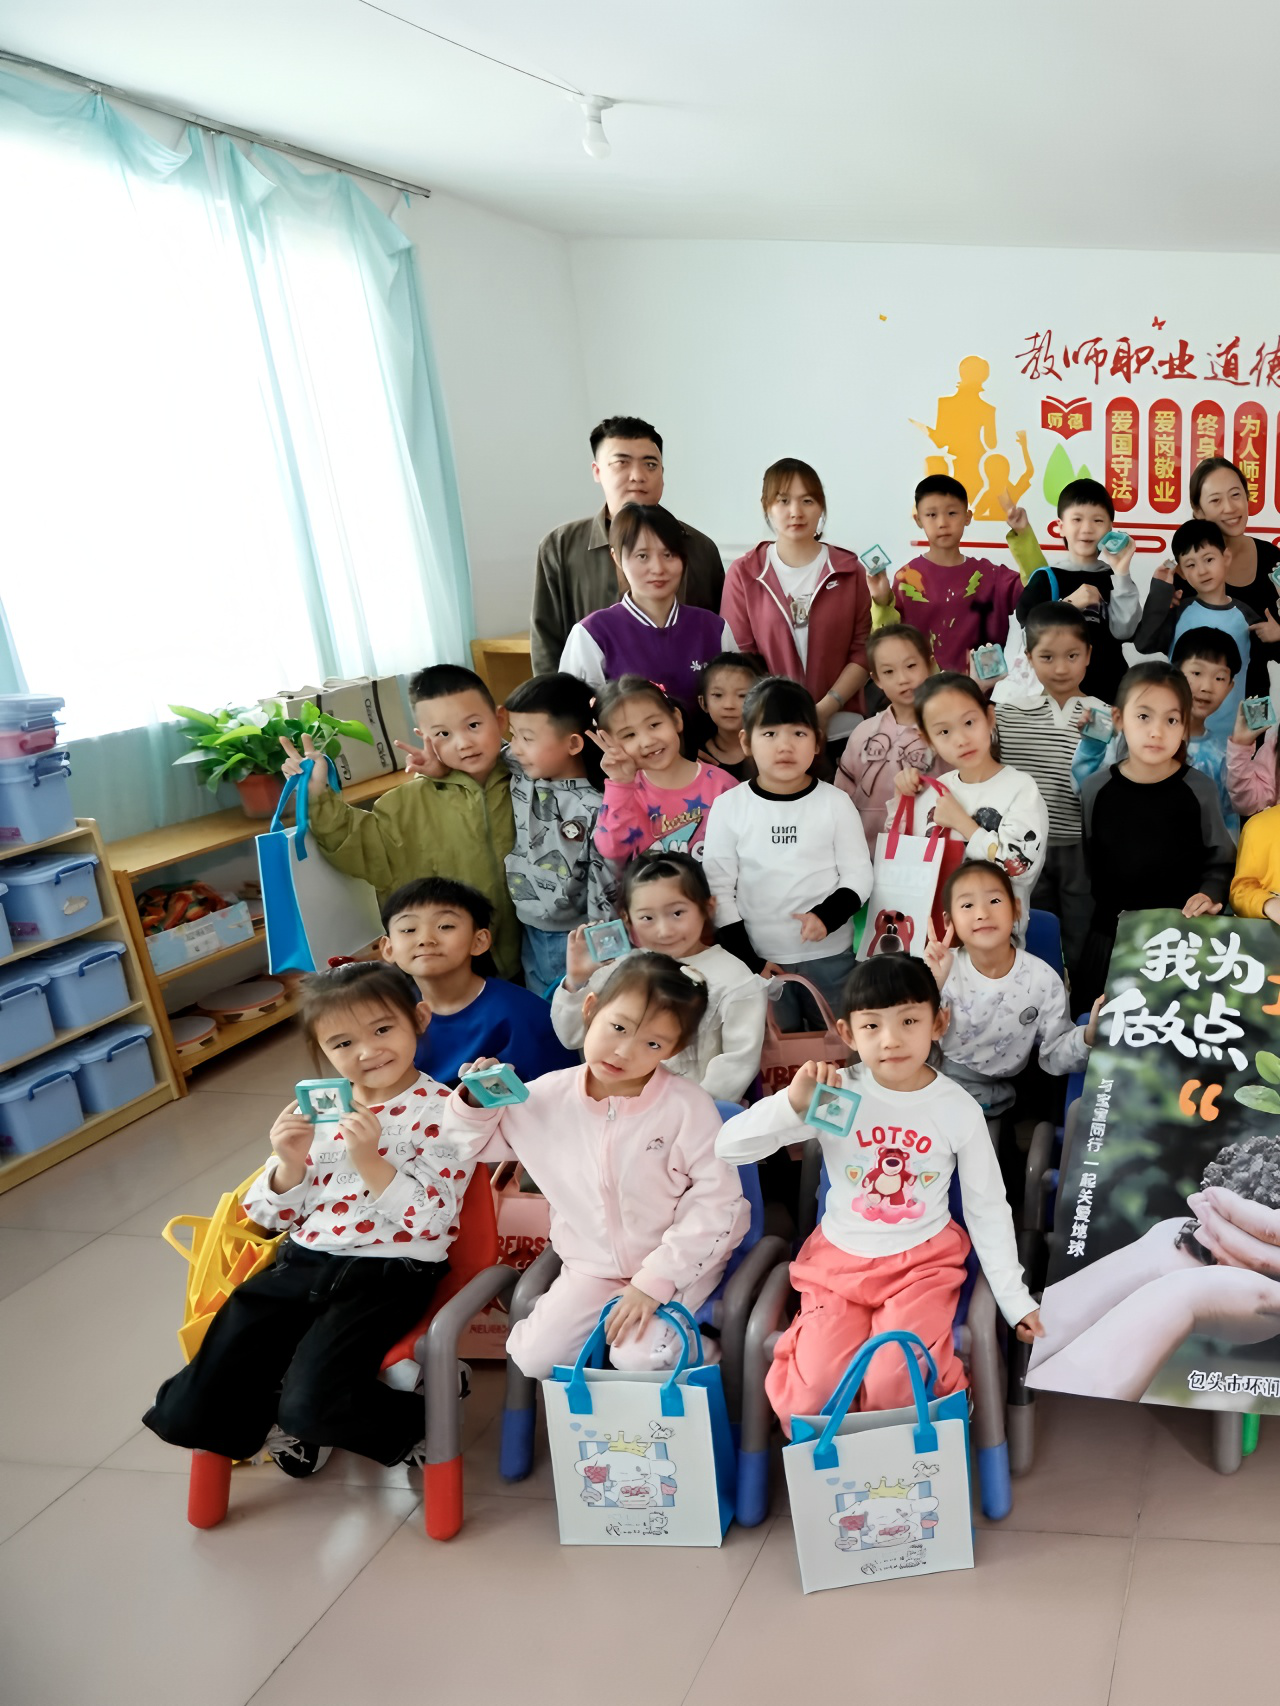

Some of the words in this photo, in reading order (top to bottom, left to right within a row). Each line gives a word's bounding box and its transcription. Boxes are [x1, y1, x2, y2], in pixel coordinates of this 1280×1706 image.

[1047, 412, 1084, 430] 师德
[1111, 410, 1133, 500] 爱国守法
[1195, 413, 1218, 467] 终身
[1154, 410, 1176, 503] 爱岗敬业
[1099, 988, 1249, 1071] 做点
[856, 1126, 932, 1154] LOTSO
